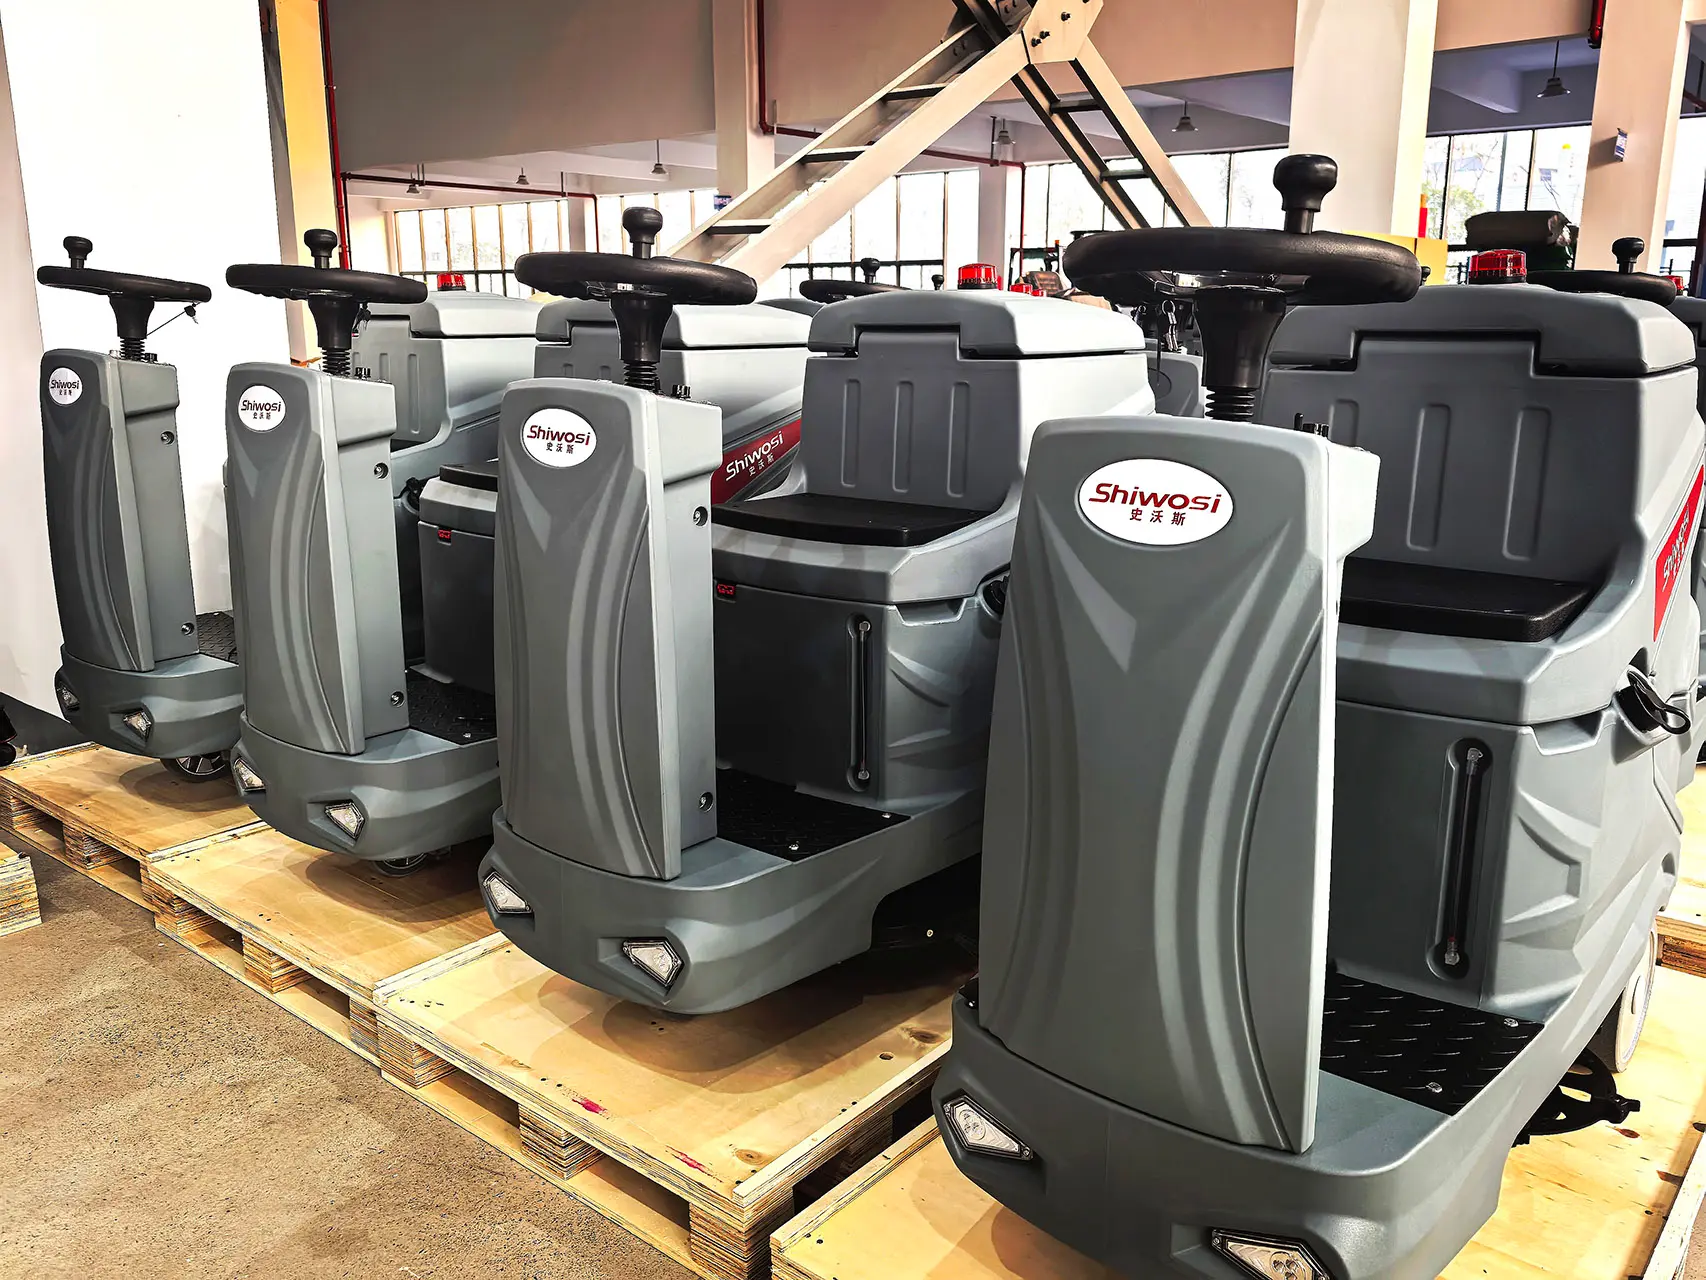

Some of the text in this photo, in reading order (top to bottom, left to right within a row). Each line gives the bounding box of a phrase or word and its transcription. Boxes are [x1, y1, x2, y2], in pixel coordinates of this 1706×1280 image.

[50, 380, 79, 389] Shiwosi
[241, 400, 282, 412] Shiwosi
[526, 424, 591, 446] Shiwosi
[546, 442, 575, 455] 史沃斯
[725, 430, 784, 482] Shiwosi
[1088, 482, 1222, 514] Shiwosi
[1129, 507, 1187, 526] 史沃斯
